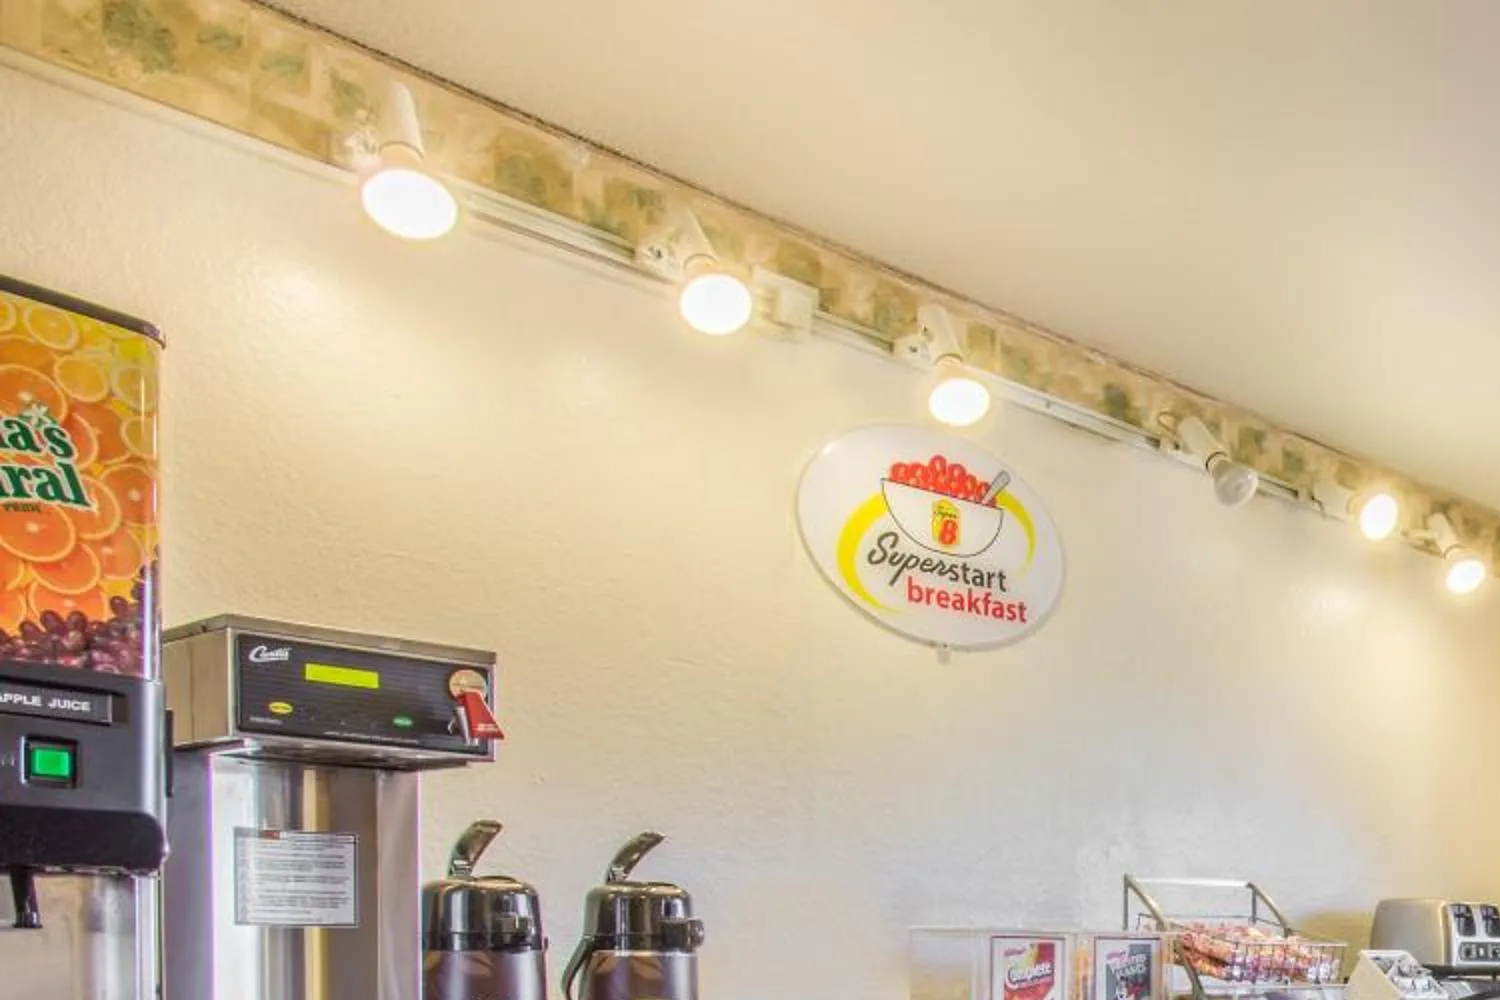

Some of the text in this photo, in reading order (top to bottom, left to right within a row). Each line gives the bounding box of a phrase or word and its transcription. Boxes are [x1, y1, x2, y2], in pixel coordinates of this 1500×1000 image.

[0, 462, 91, 507] ral
[867, 531, 1007, 592] Superstart
[907, 575, 1028, 624] breakfast
[48, 697, 91, 712] JUICE
